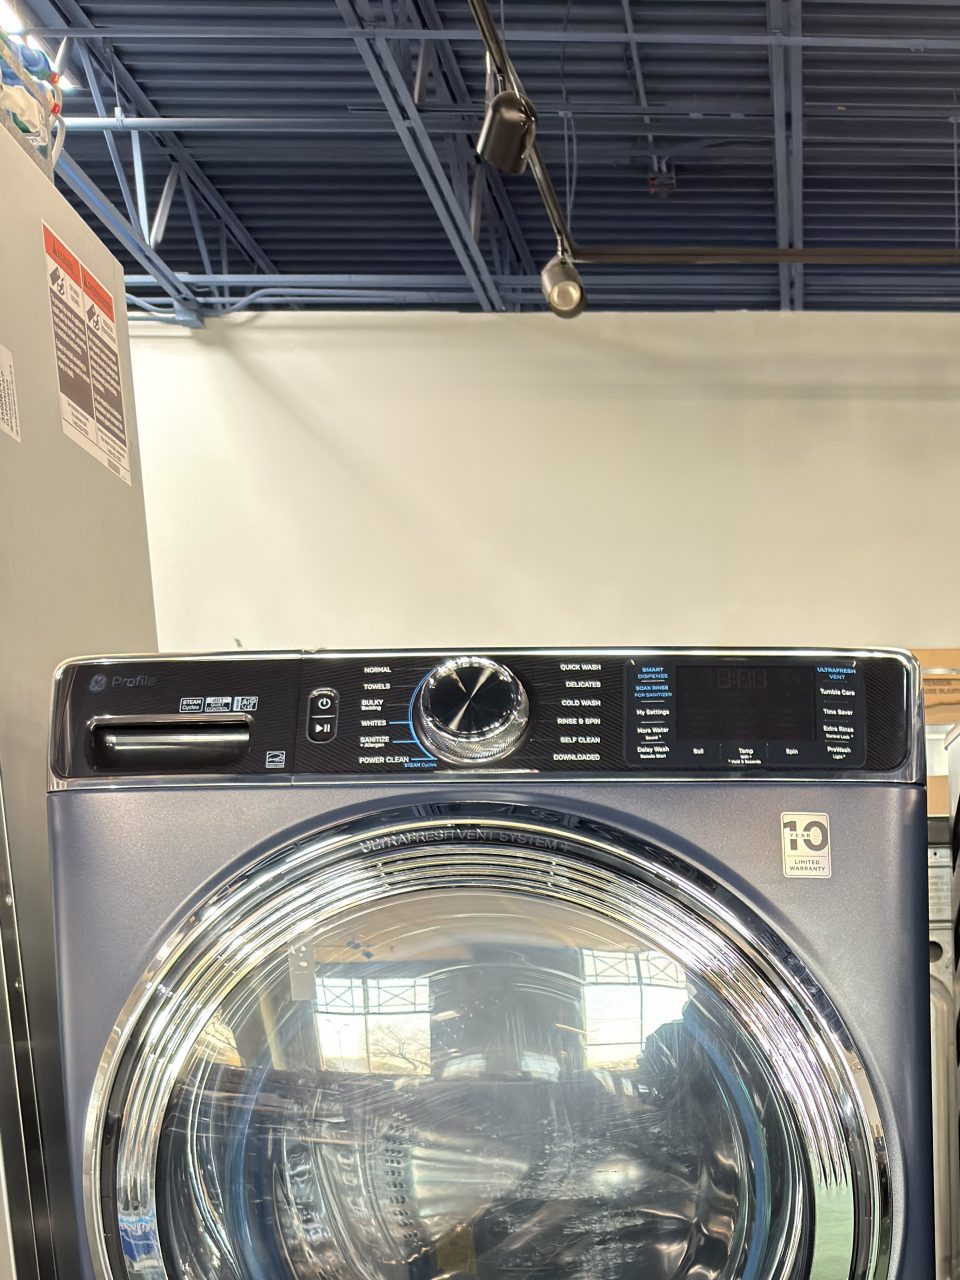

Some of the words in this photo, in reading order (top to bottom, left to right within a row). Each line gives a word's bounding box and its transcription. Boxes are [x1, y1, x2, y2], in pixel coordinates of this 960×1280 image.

[817, 666, 857, 674] ULTRAFRESH
[112, 675, 157, 687] Profile
[557, 717, 577, 725] RINSE
[359, 829, 455, 853] ULTRAFRESH
[456, 828, 493, 841] VENT
[499, 831, 557, 850] SYSTEM
[783, 820, 828, 852] 10
